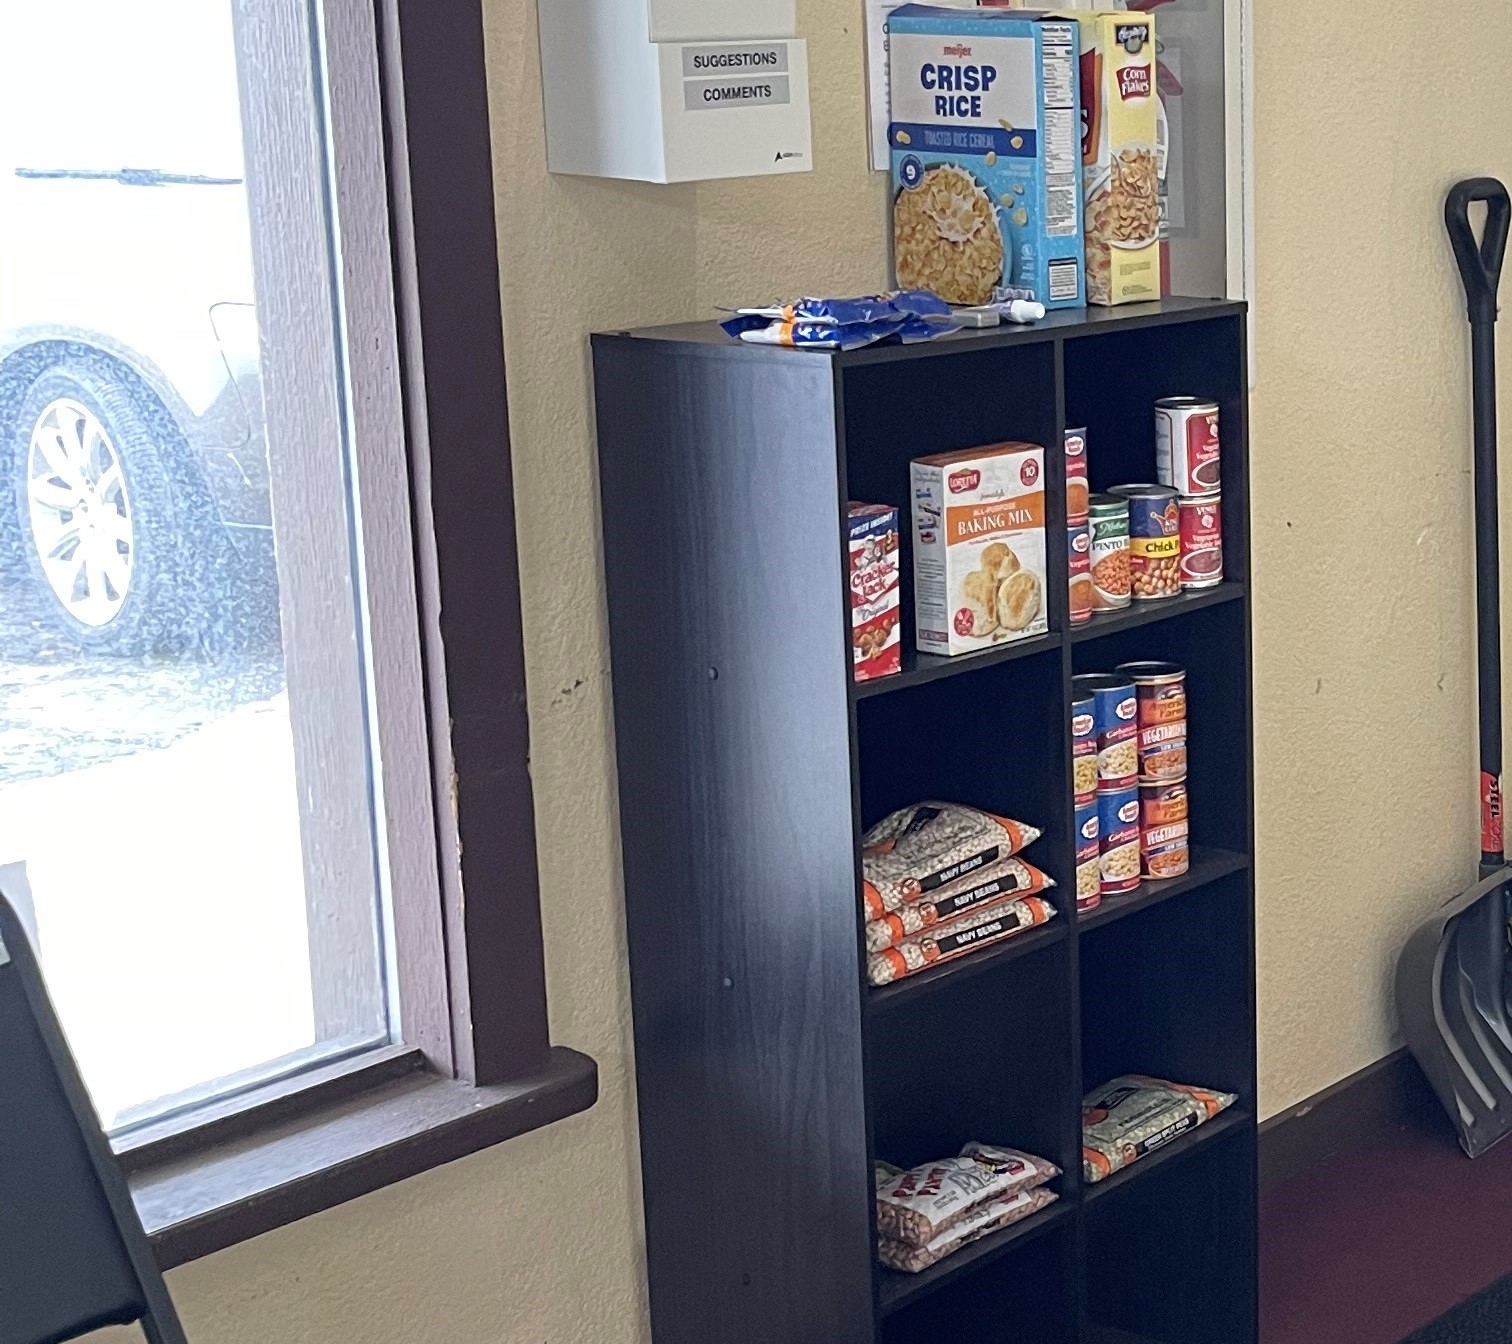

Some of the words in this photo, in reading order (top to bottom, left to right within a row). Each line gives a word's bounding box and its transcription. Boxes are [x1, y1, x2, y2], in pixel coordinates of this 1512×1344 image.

[943, 43, 972, 58] meijer
[693, 52, 777, 69] SUGGESTIONS
[920, 63, 997, 92] CRISP
[1123, 67, 1147, 81] Corn
[703, 85, 772, 102] COMMENTS
[1121, 81, 1149, 96] Flakes
[934, 95, 982, 117] RICE
[1024, 466, 1036, 477] 10
[957, 513, 1005, 536] BAKING
[1008, 508, 1034, 526] MIX
[1091, 540, 1123, 551] PINTO
[1145, 541, 1174, 553] Chick
[852, 561, 896, 588] Cracker
[863, 575, 887, 597] Jack
